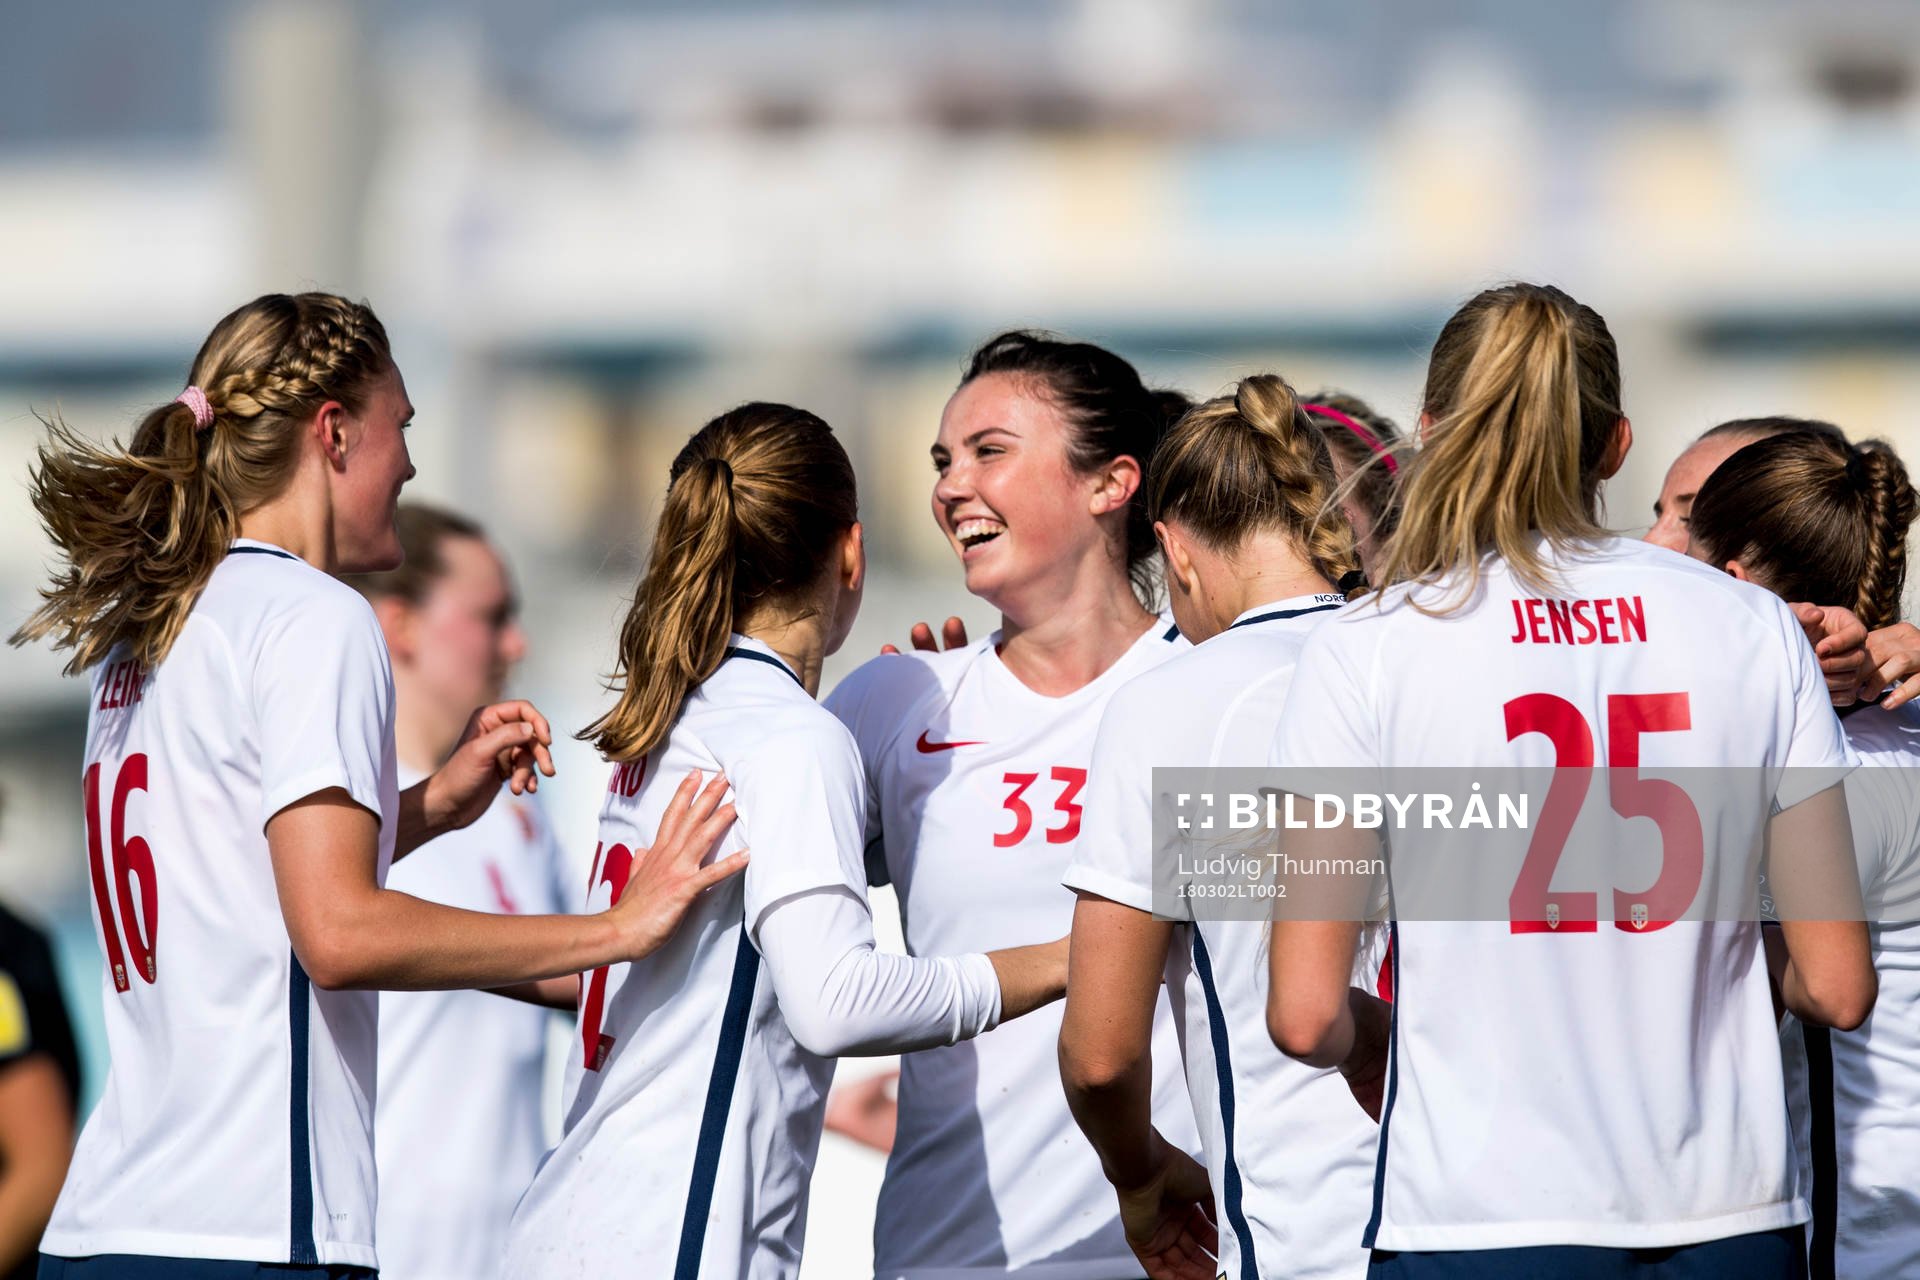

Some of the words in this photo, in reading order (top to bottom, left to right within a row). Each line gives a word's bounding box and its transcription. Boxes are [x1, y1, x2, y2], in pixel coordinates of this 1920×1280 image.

[1511, 596, 1647, 645] JENSEN
[83, 752, 158, 993] 16
[993, 766, 1087, 848] 33
[1503, 692, 1704, 934] 25
